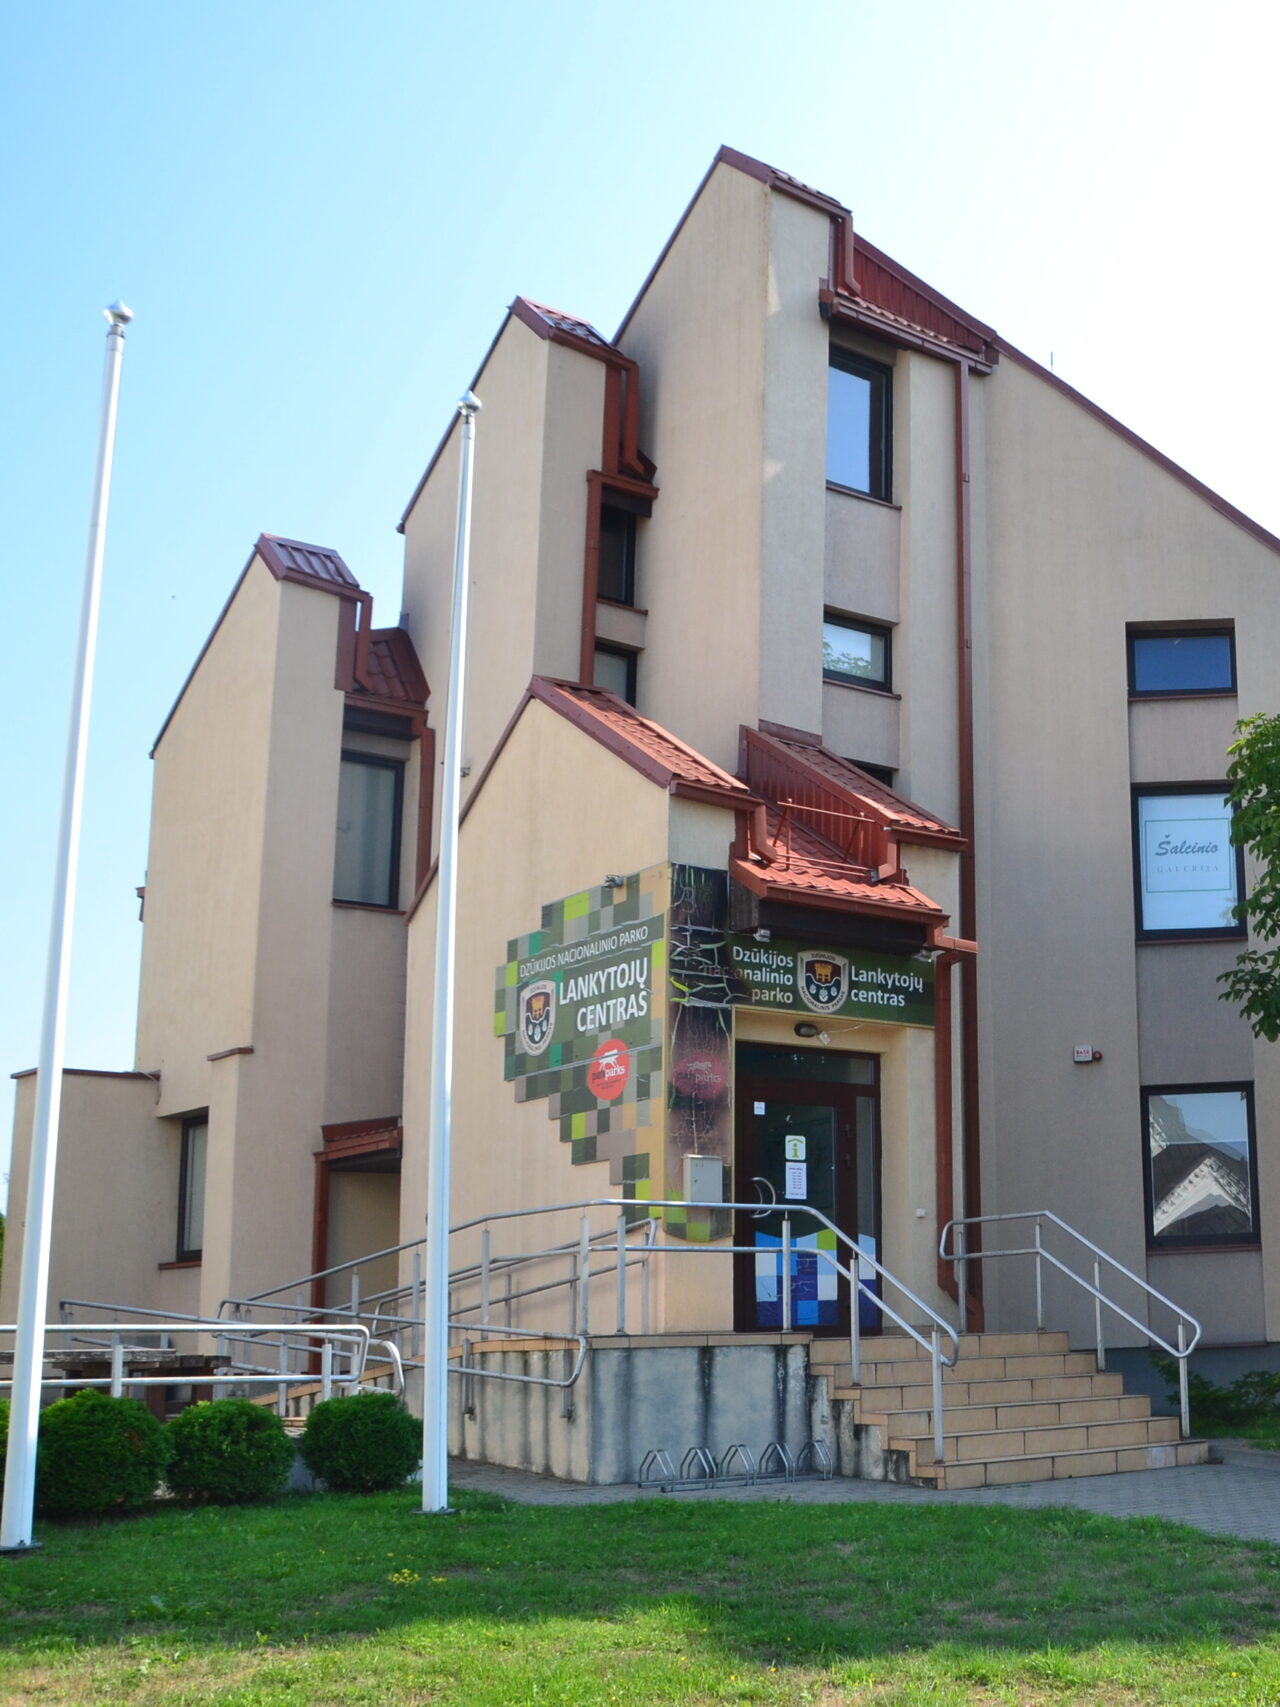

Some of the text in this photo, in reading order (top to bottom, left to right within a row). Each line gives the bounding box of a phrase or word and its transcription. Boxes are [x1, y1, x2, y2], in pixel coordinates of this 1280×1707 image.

[519, 926, 649, 978] DZŪKIJOS NACIONALINIO PARKO
[732, 946, 794, 968] Dzūkijos
[559, 957, 648, 1006] LANKYTOJŲ
[851, 965, 924, 993] Lankytojų
[751, 987, 793, 1004] parko
[850, 989, 905, 1007] centras
[576, 991, 648, 1032] CENTRAS
